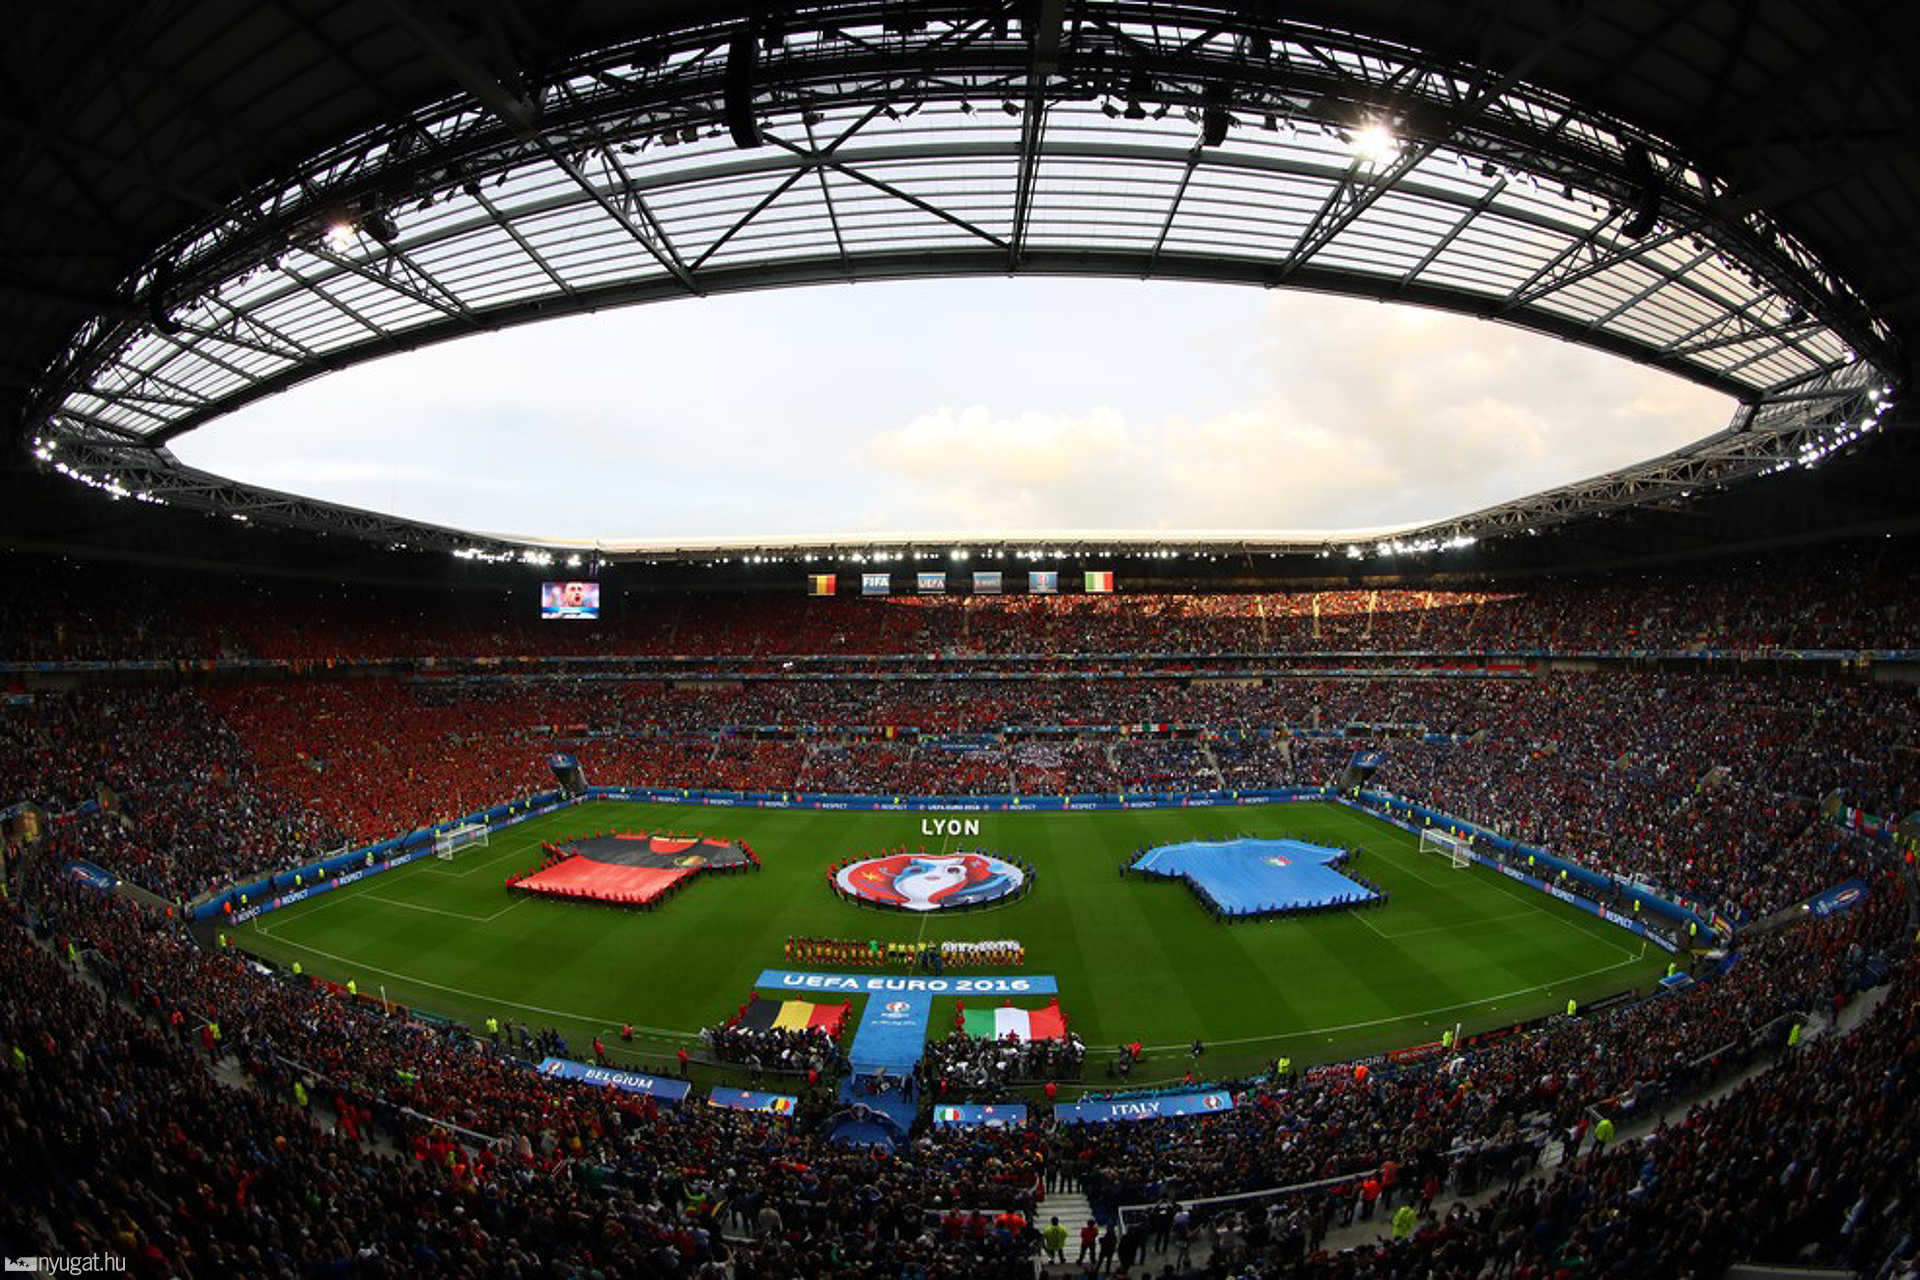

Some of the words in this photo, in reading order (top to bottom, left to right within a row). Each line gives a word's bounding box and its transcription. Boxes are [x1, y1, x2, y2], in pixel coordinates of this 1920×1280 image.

[863, 577, 889, 587] FIFA
[921, 819, 980, 835] LYON
[783, 974, 859, 990] UEFA
[867, 977, 948, 991] EURO
[955, 979, 1030, 991] 2016
[585, 1069, 654, 1089] BELGIUM
[1111, 1101, 1160, 1116] ITALY
